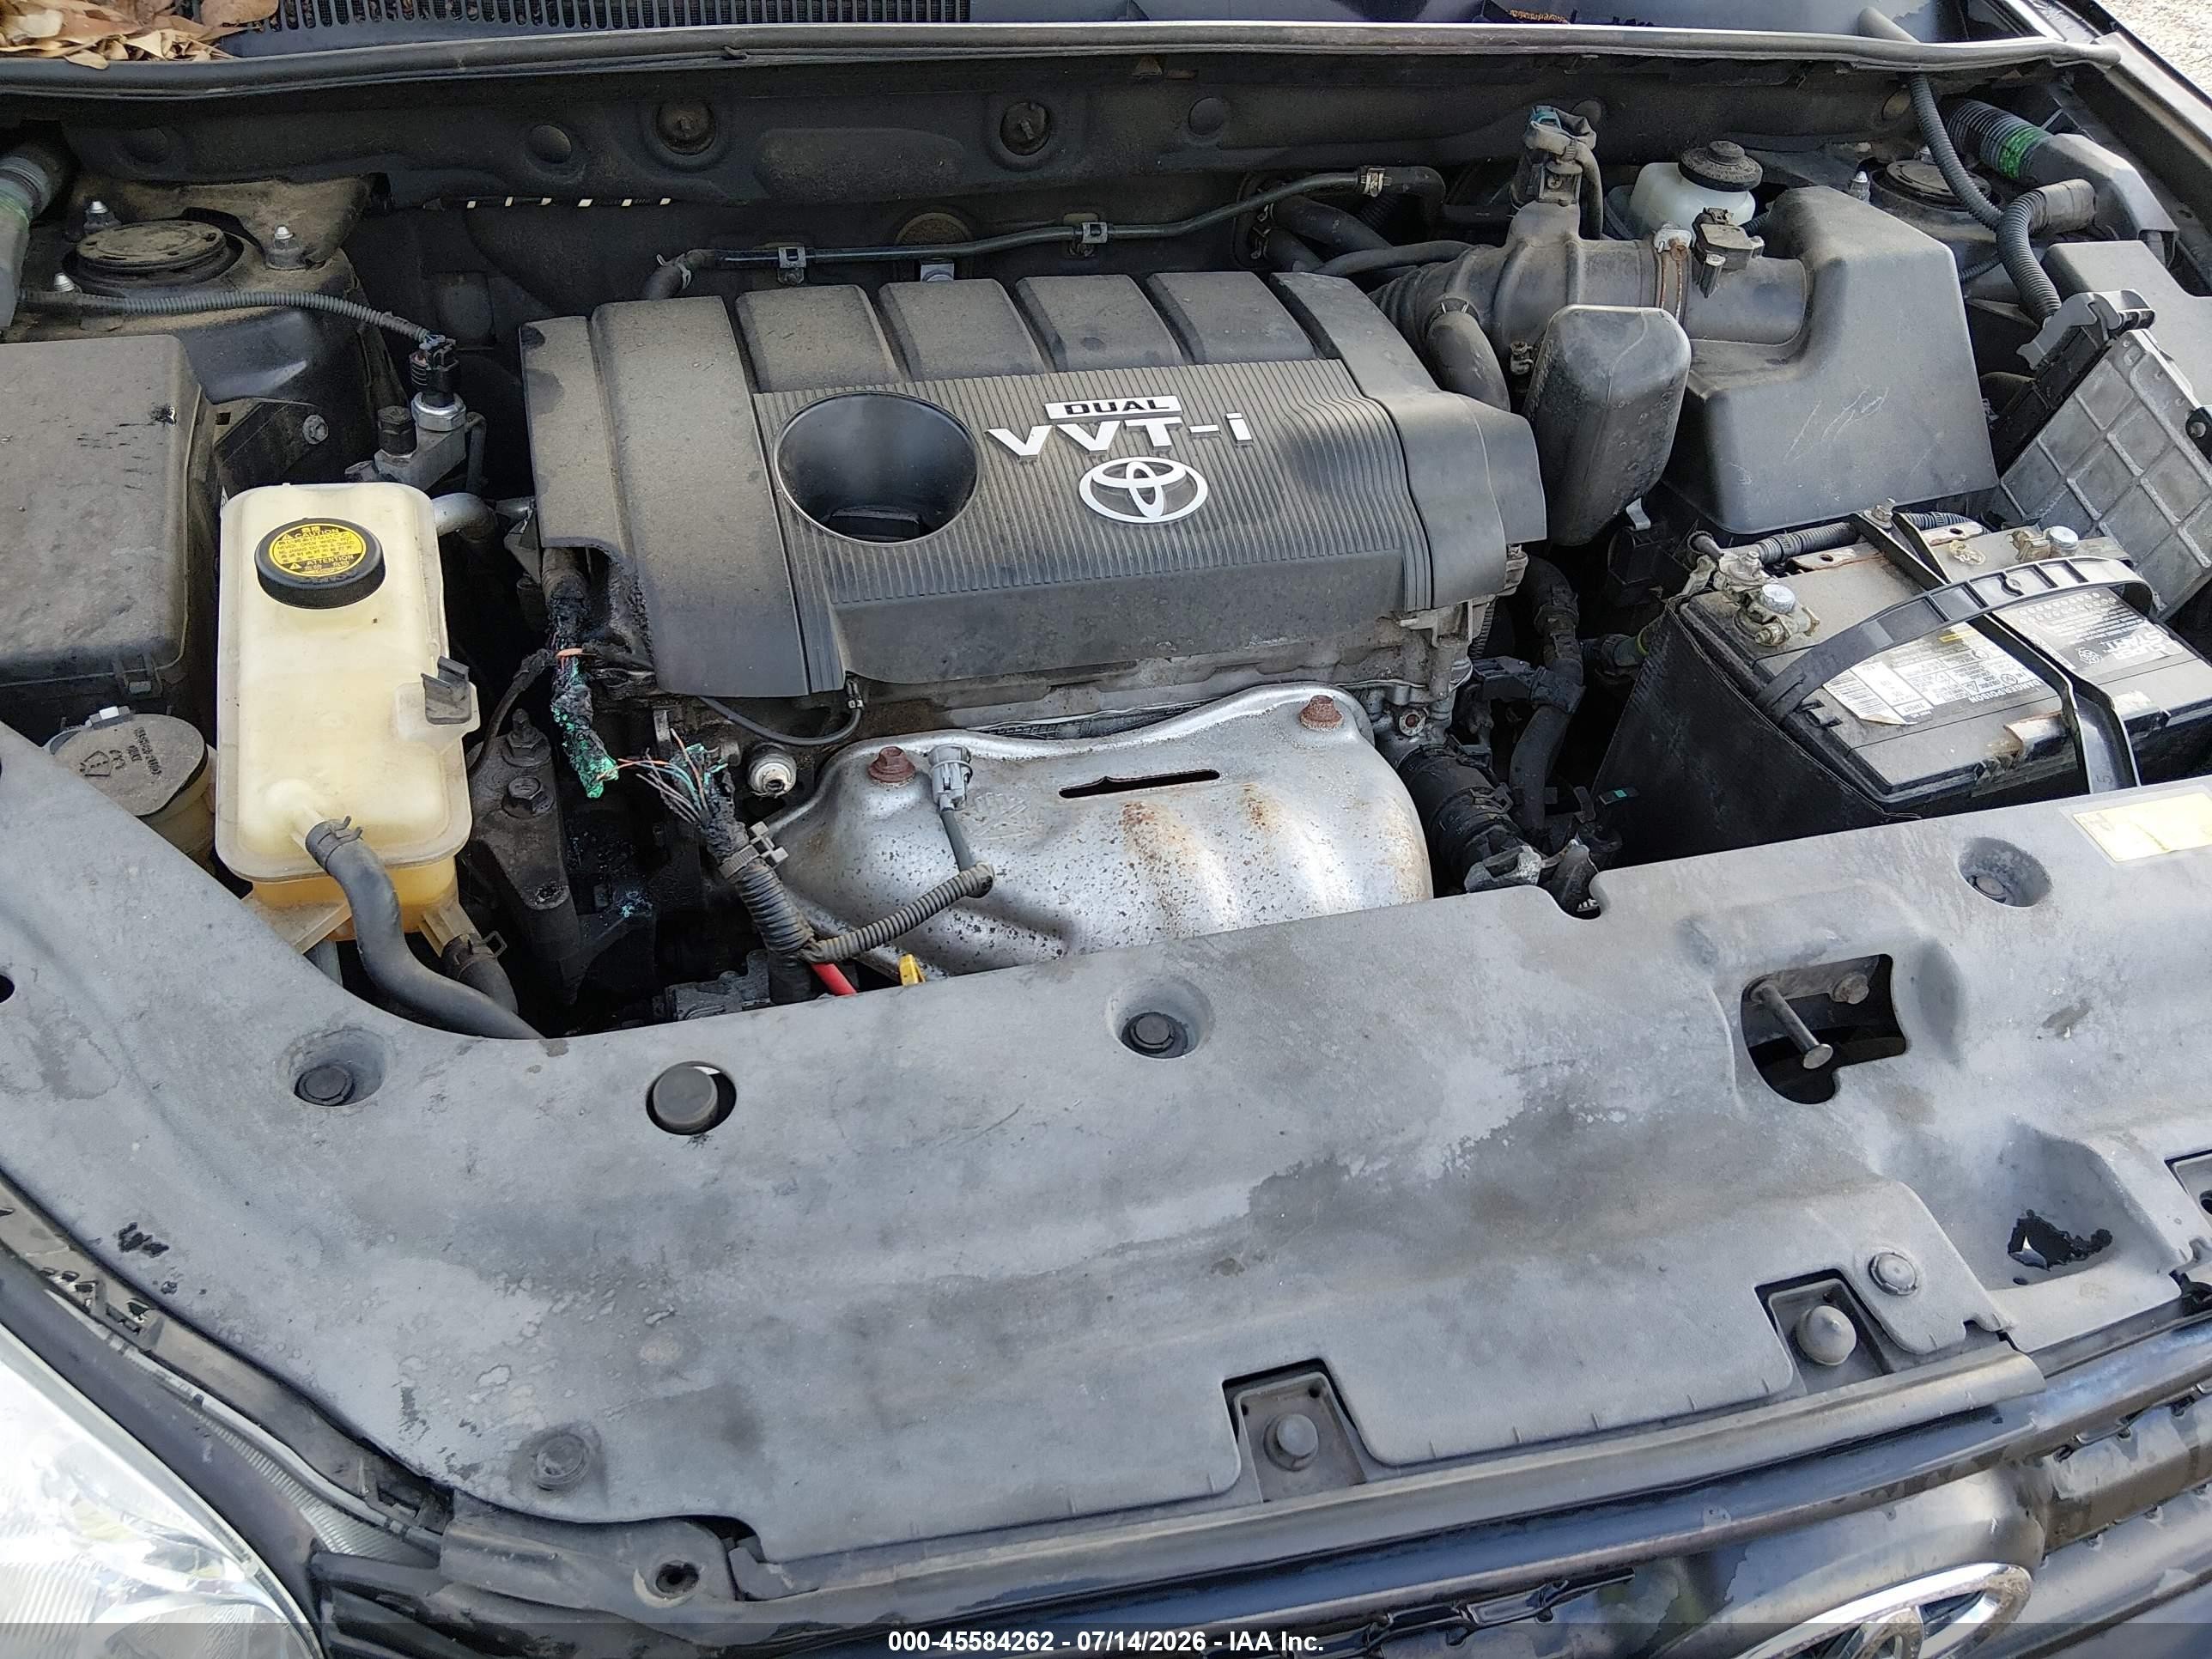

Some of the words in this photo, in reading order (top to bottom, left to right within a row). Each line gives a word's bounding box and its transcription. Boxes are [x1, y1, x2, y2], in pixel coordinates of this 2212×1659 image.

[1064, 399, 1170, 416] DUAL
[987, 412, 1253, 457] VVT-i
[295, 528, 339, 538] CAUTION
[306, 554, 355, 565] ATTENTION
[2105, 631, 2163, 653] START
[2112, 642, 2165, 660] SUPER
